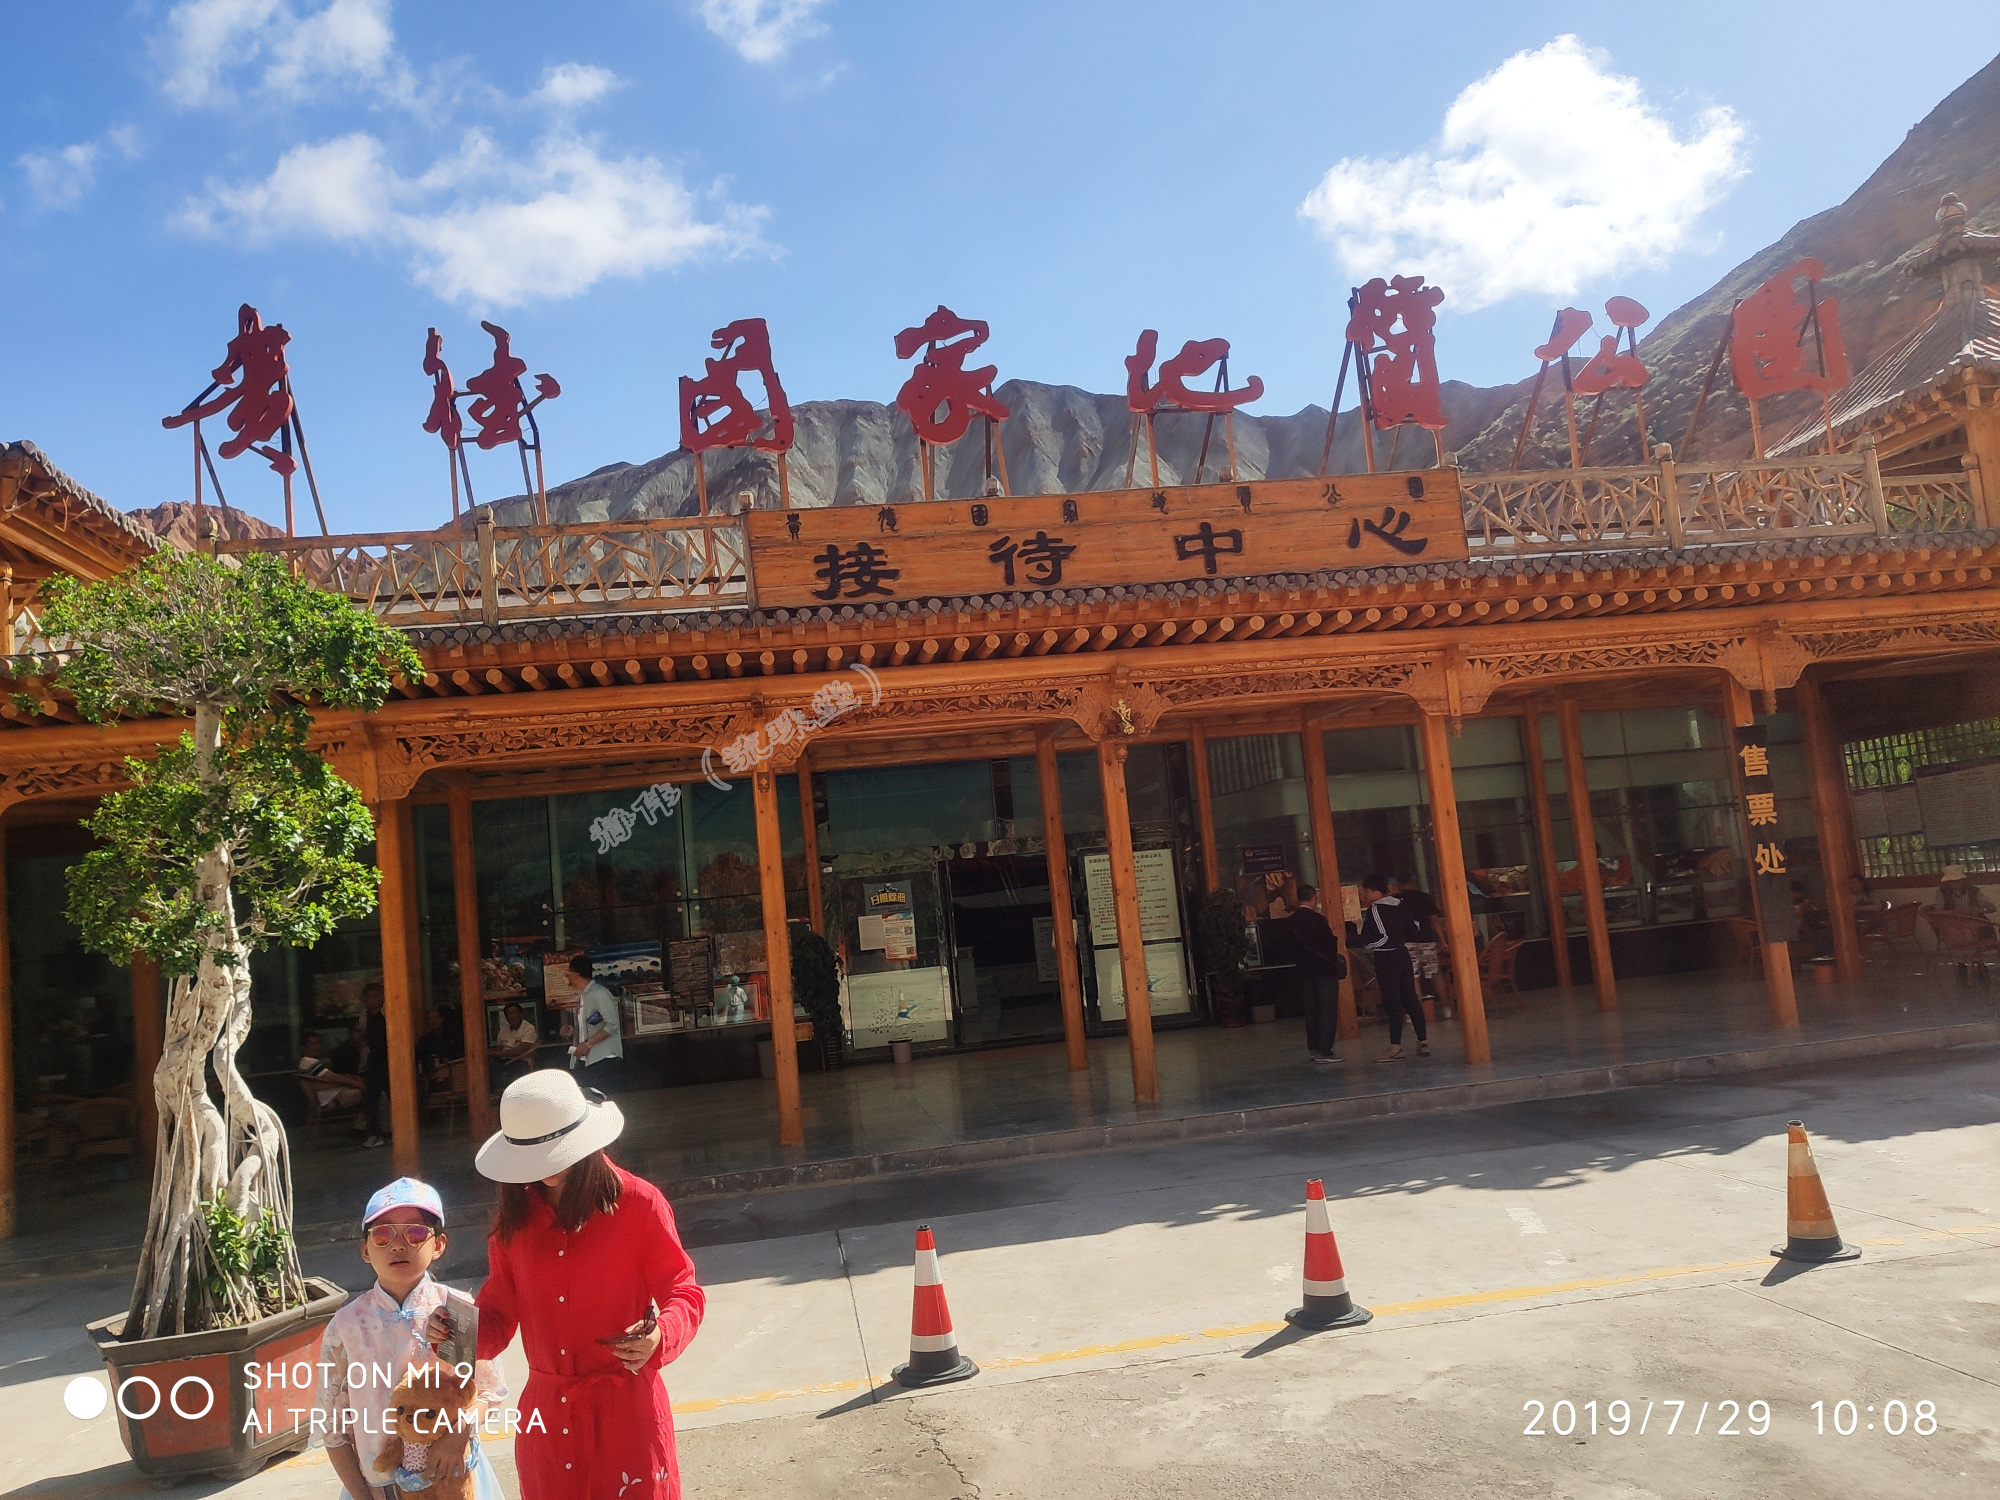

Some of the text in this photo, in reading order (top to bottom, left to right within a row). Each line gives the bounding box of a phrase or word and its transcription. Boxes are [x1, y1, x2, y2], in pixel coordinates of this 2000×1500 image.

[811, 507, 1428, 601] 接待中心
[1739, 744, 1786, 876] 售票处
